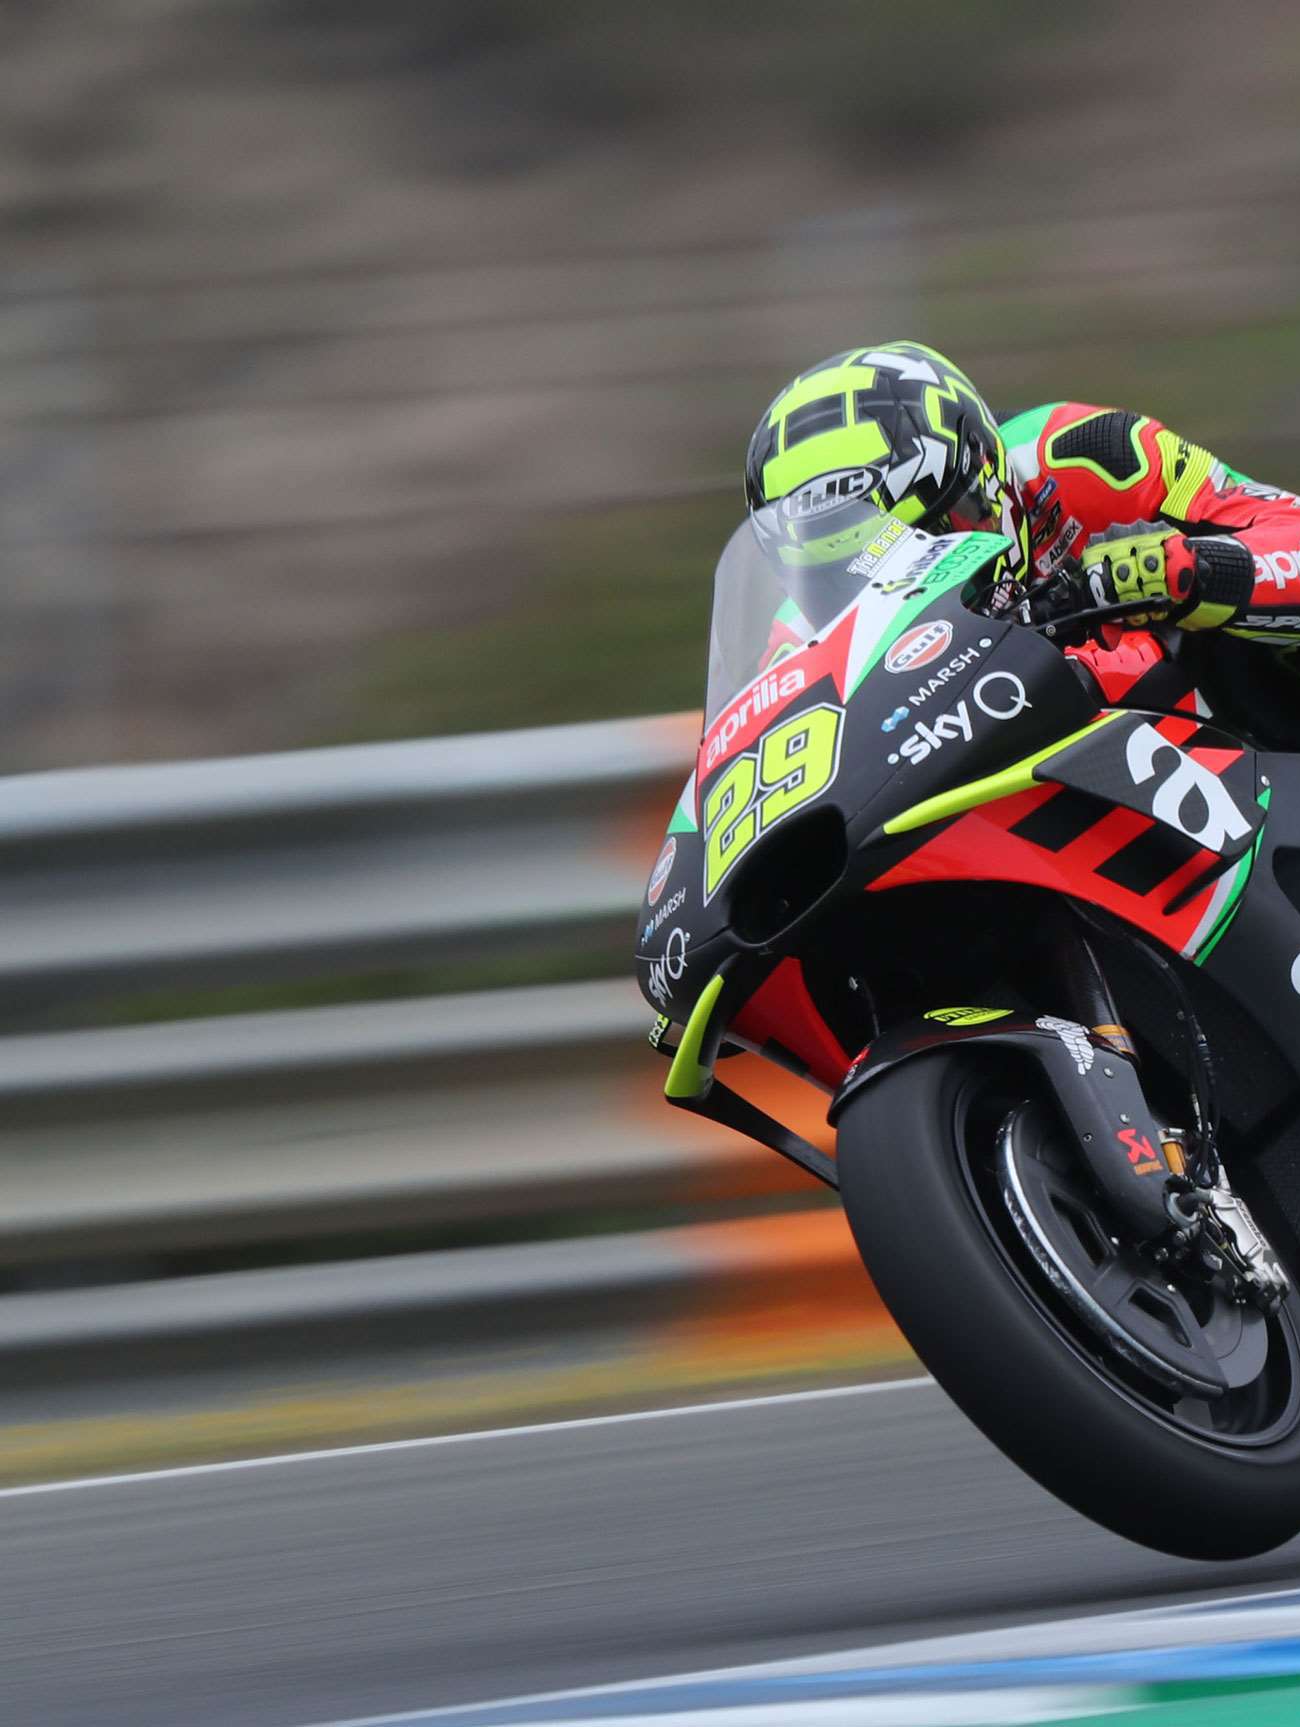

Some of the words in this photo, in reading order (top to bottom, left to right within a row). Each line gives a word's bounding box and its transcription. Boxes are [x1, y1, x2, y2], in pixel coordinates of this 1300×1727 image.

[789, 470, 866, 514] HJC
[908, 647, 980, 707] MARSH
[705, 666, 805, 769] aprilia
[704, 702, 846, 907] 29
[655, 887, 687, 931] MARSH
